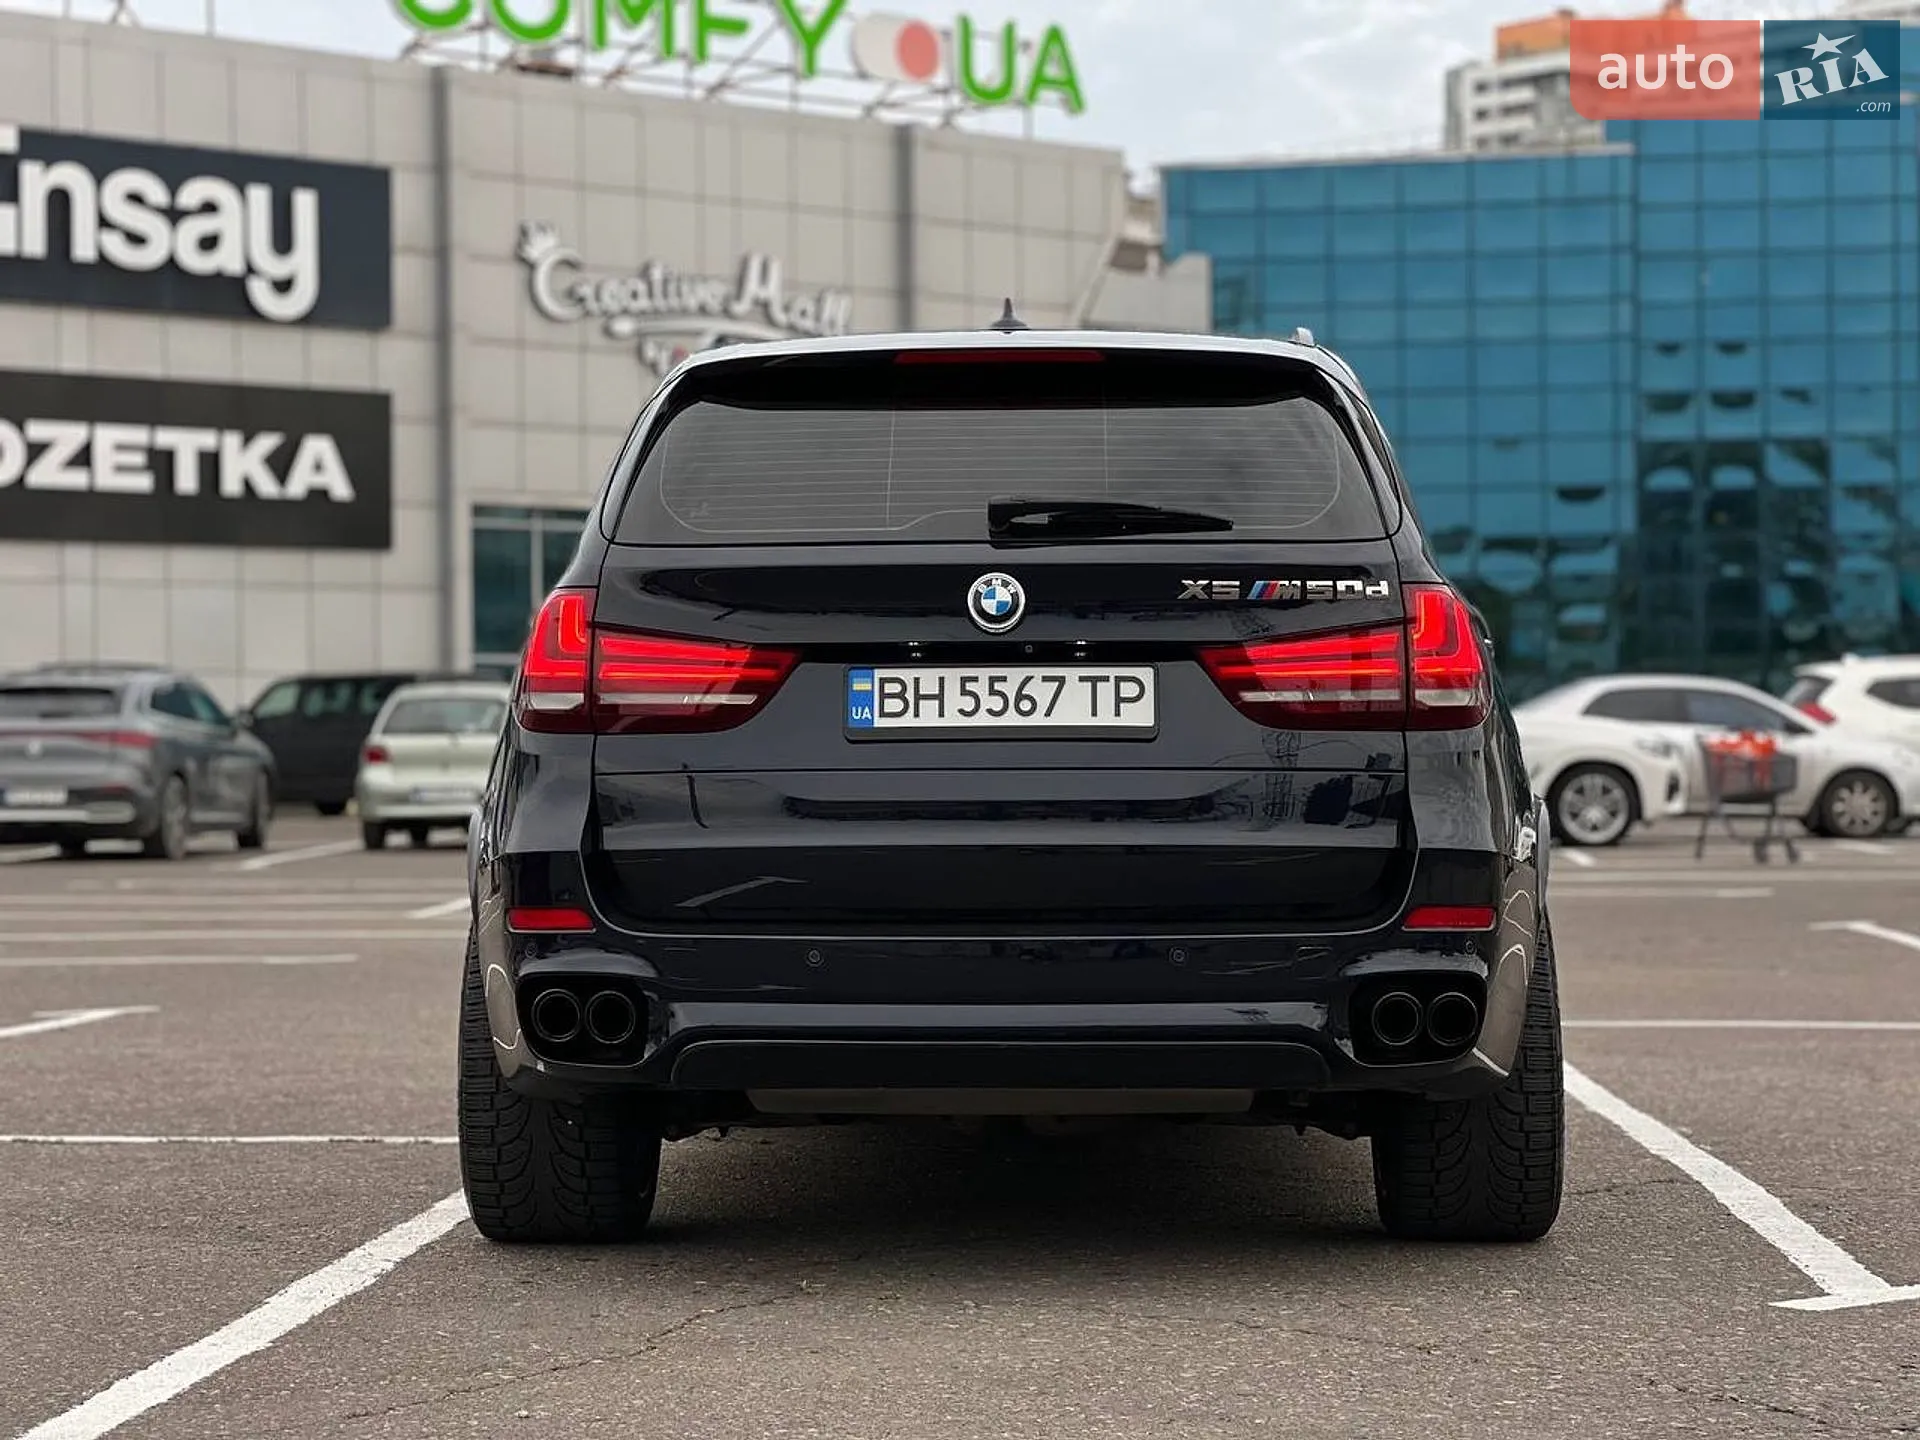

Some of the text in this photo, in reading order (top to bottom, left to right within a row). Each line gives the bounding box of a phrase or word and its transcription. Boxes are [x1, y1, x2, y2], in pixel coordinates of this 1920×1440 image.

[399, 0, 1086, 114] MFY UA
[976, 578, 1017, 594] BMW
[1176, 579, 1240, 601] X5
[878, 675, 1147, 719] BH 5567 TP
[852, 706, 872, 720] UA
